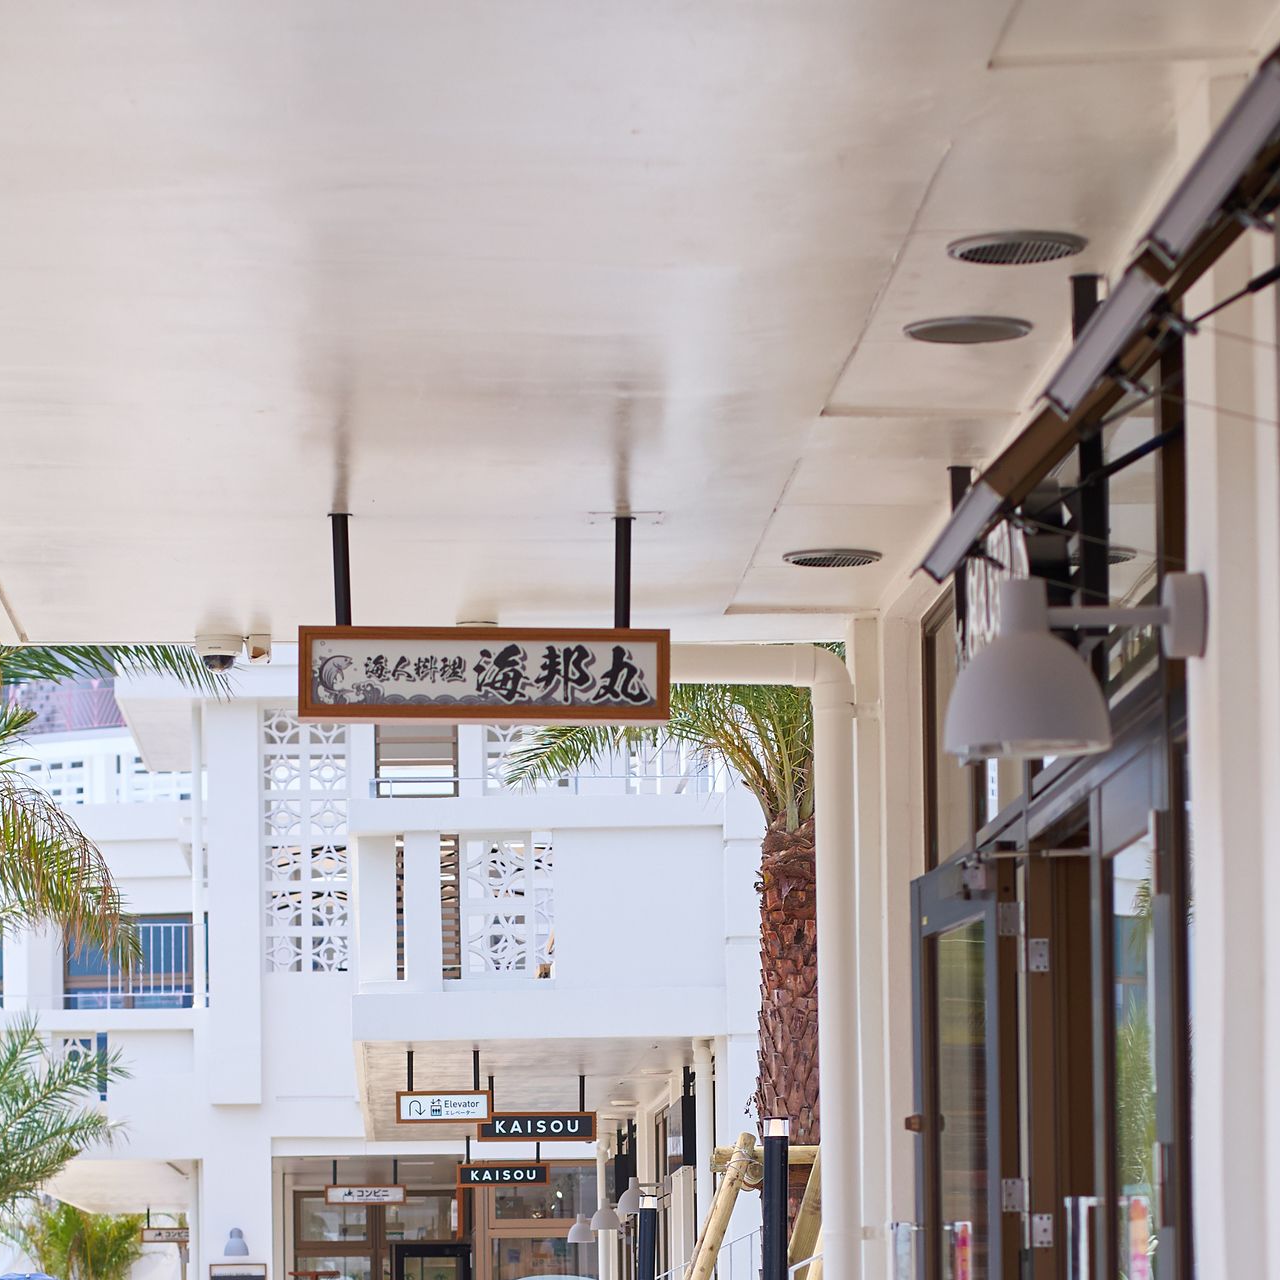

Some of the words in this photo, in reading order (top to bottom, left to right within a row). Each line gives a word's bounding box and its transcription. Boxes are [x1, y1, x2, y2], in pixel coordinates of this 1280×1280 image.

[364, 655, 466, 683] 海人料理
[473, 644, 650, 704] 海邦丸
[444, 1099, 480, 1108] Elevator
[495, 1119, 580, 1134] KAISOU
[470, 1169, 537, 1181] KAISOU
[356, 1189, 389, 1197] コンビニ
